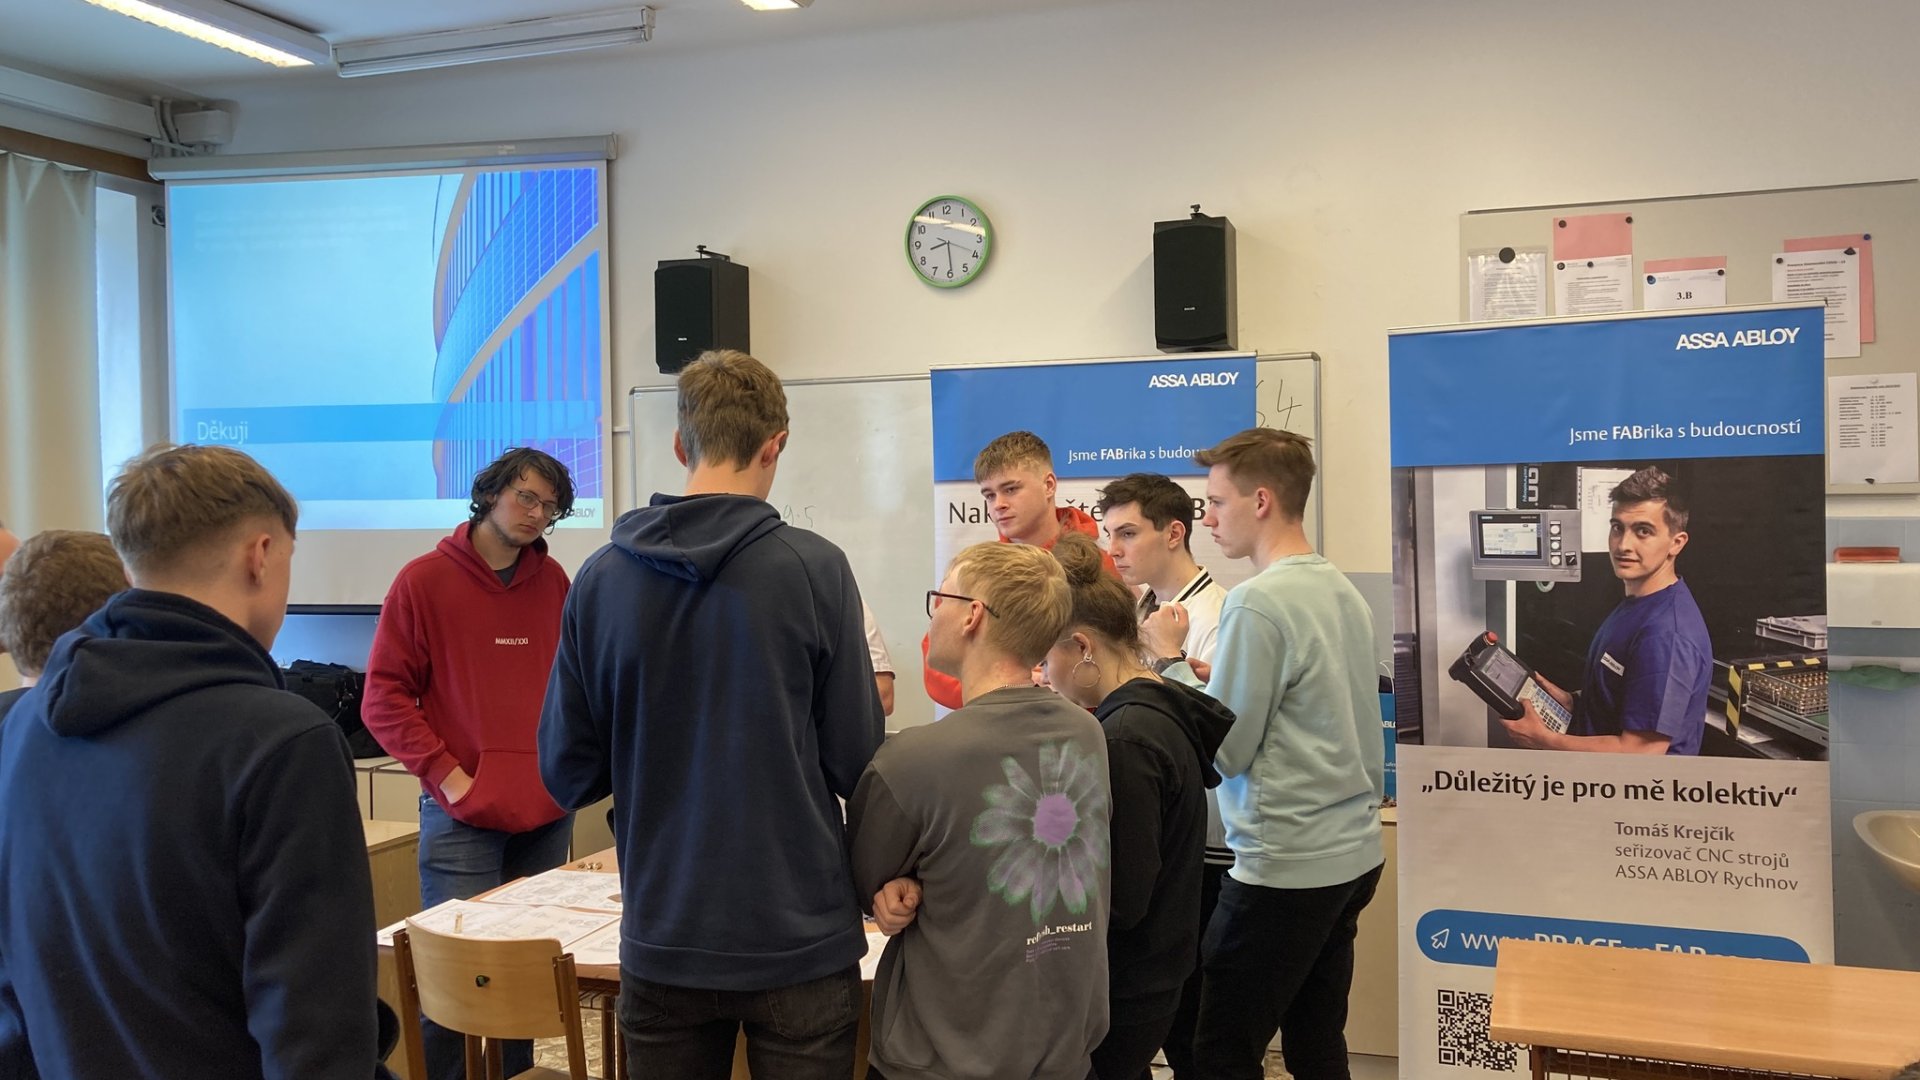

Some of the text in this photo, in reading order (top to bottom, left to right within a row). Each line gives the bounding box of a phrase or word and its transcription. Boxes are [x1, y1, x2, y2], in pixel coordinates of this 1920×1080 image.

[942, 204, 952, 215] 12
[970, 218, 977, 227] 2
[917, 224, 926, 235] 10
[976, 233, 983, 244] 3
[914, 241, 922, 250] 9
[971, 250, 979, 259] 4
[920, 256, 927, 266] 8
[932, 266, 938, 276] 7
[946, 269, 954, 278] 6
[962, 263, 969, 273] 5
[1676, 291, 1693, 300] 3.B
[1675, 327, 1800, 350] ASSA ABLOY
[1149, 371, 1240, 388] ASSA ABLOY
[197, 420, 248, 444] Děkuji
[1569, 418, 1801, 445] Jsme FABrika s budoucností
[1068, 449, 1098, 464] Jsme
[1100, 446, 1146, 460] FABrika
[1150, 449, 1156, 459] s
[1541, 775, 1565, 801] je
[1572, 781, 1616, 802] pro
[1624, 779, 1665, 801] mě
[1614, 821, 1735, 843] Tomáš Krejčík
[1615, 843, 1789, 871] seřizovač CNC strojů
[1615, 864, 1799, 890] ASSA ABLOY Rychnov
